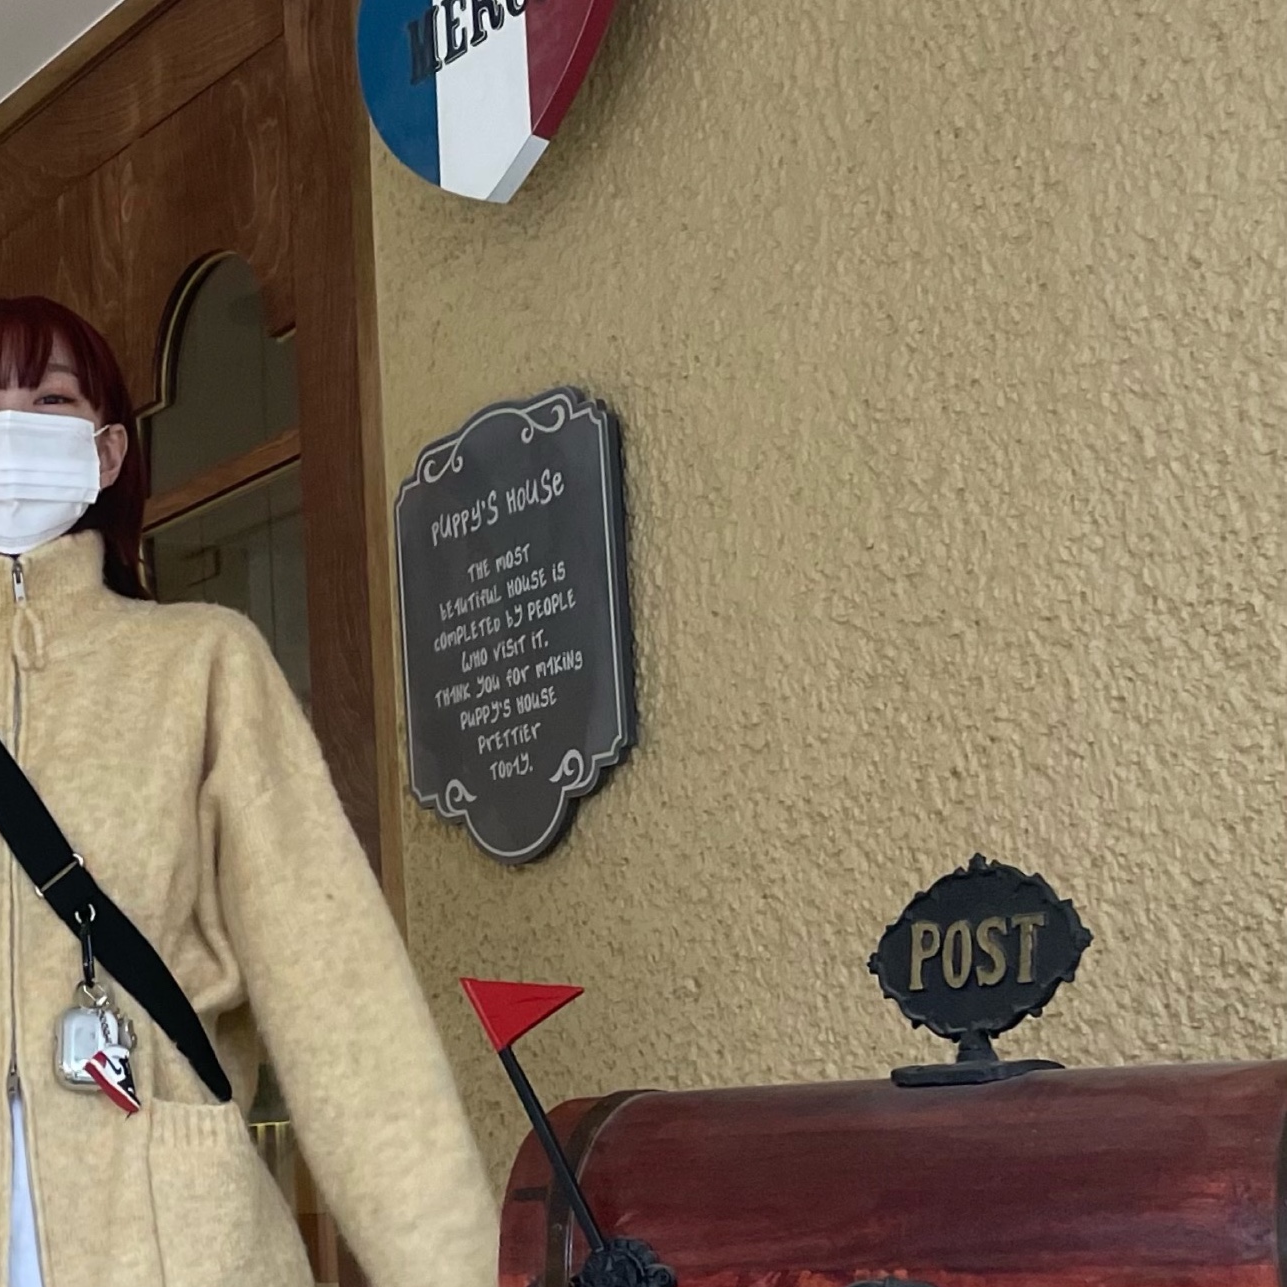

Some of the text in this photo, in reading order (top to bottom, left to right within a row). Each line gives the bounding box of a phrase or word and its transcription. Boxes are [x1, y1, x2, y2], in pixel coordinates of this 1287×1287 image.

[408, 0, 527, 85] MER
[467, 558, 491, 582] THE
[527, 588, 576, 621] PEOPLE
[461, 647, 488, 673] WHO
[908, 912, 1046, 991] POST
